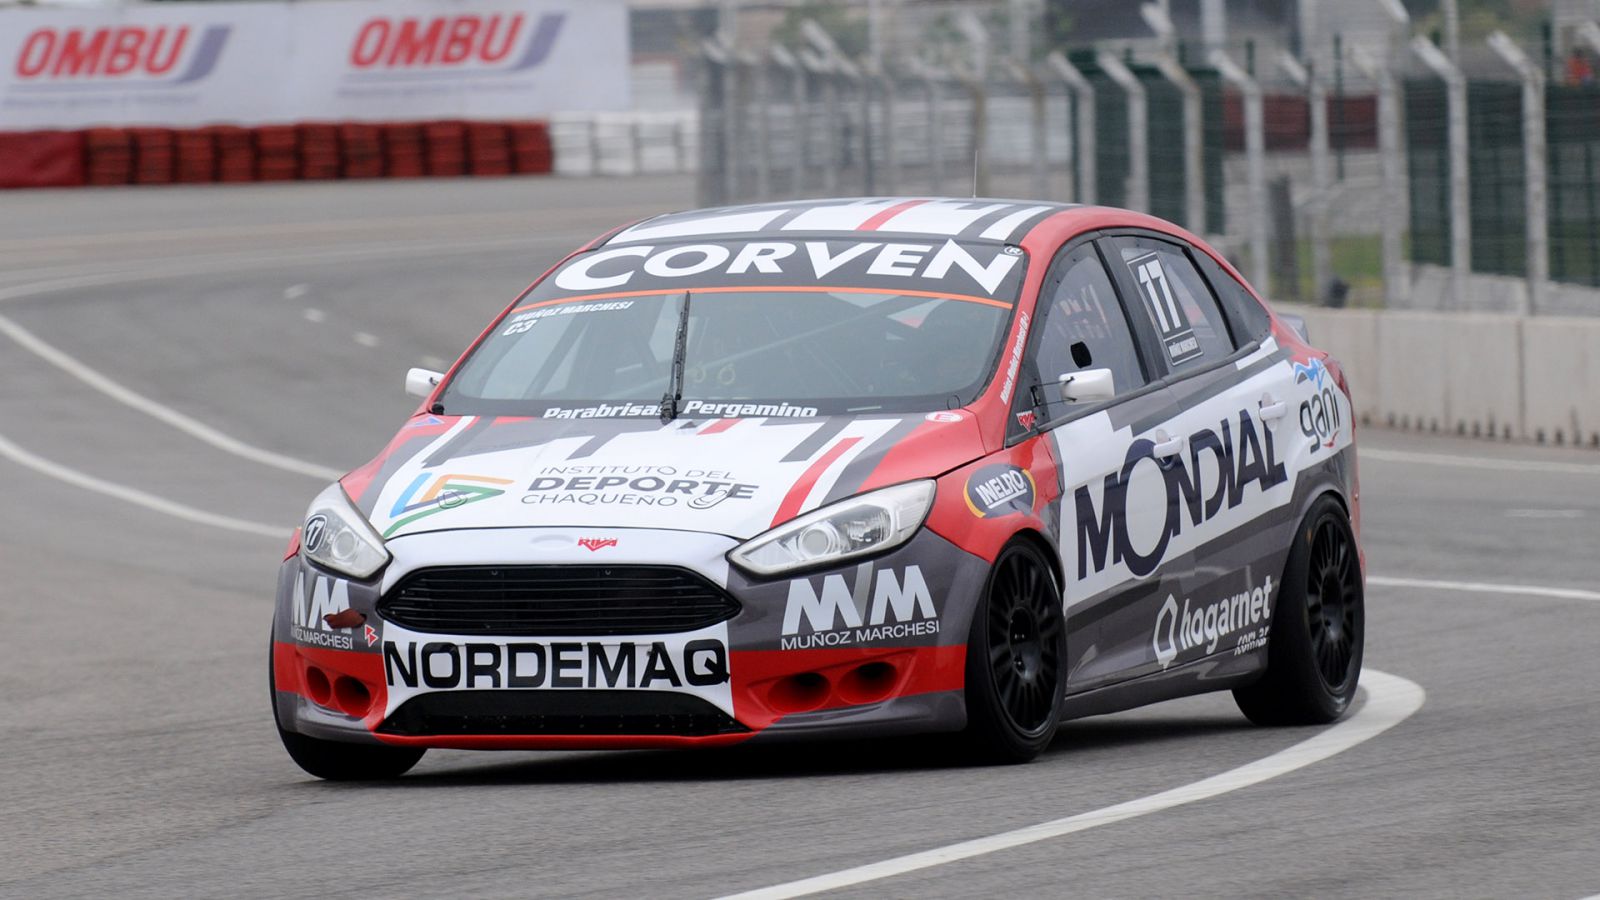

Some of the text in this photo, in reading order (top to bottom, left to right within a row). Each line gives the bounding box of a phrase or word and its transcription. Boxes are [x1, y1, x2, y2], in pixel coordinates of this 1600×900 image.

[15, 24, 191, 79] OMBU
[349, 12, 525, 69] OMBU
[555, 239, 1018, 295] CORVEN
[560, 301, 634, 315] MARCHESI
[1138, 259, 1181, 333] 17
[682, 400, 818, 418] Pergamino
[1300, 384, 1340, 454] gani
[527, 476, 760, 499] DEPORTE
[540, 465, 737, 480] INSTITUTO DEL
[1074, 408, 1288, 580] MONDIAL
[521, 492, 678, 507] CHAQUEÑO
[303, 630, 353, 650] MARCHESI
[781, 620, 939, 650] MUÑOZ MARCHESI
[1180, 575, 1272, 655] hogarnet
[383, 638, 730, 689] NORDEMAQ
